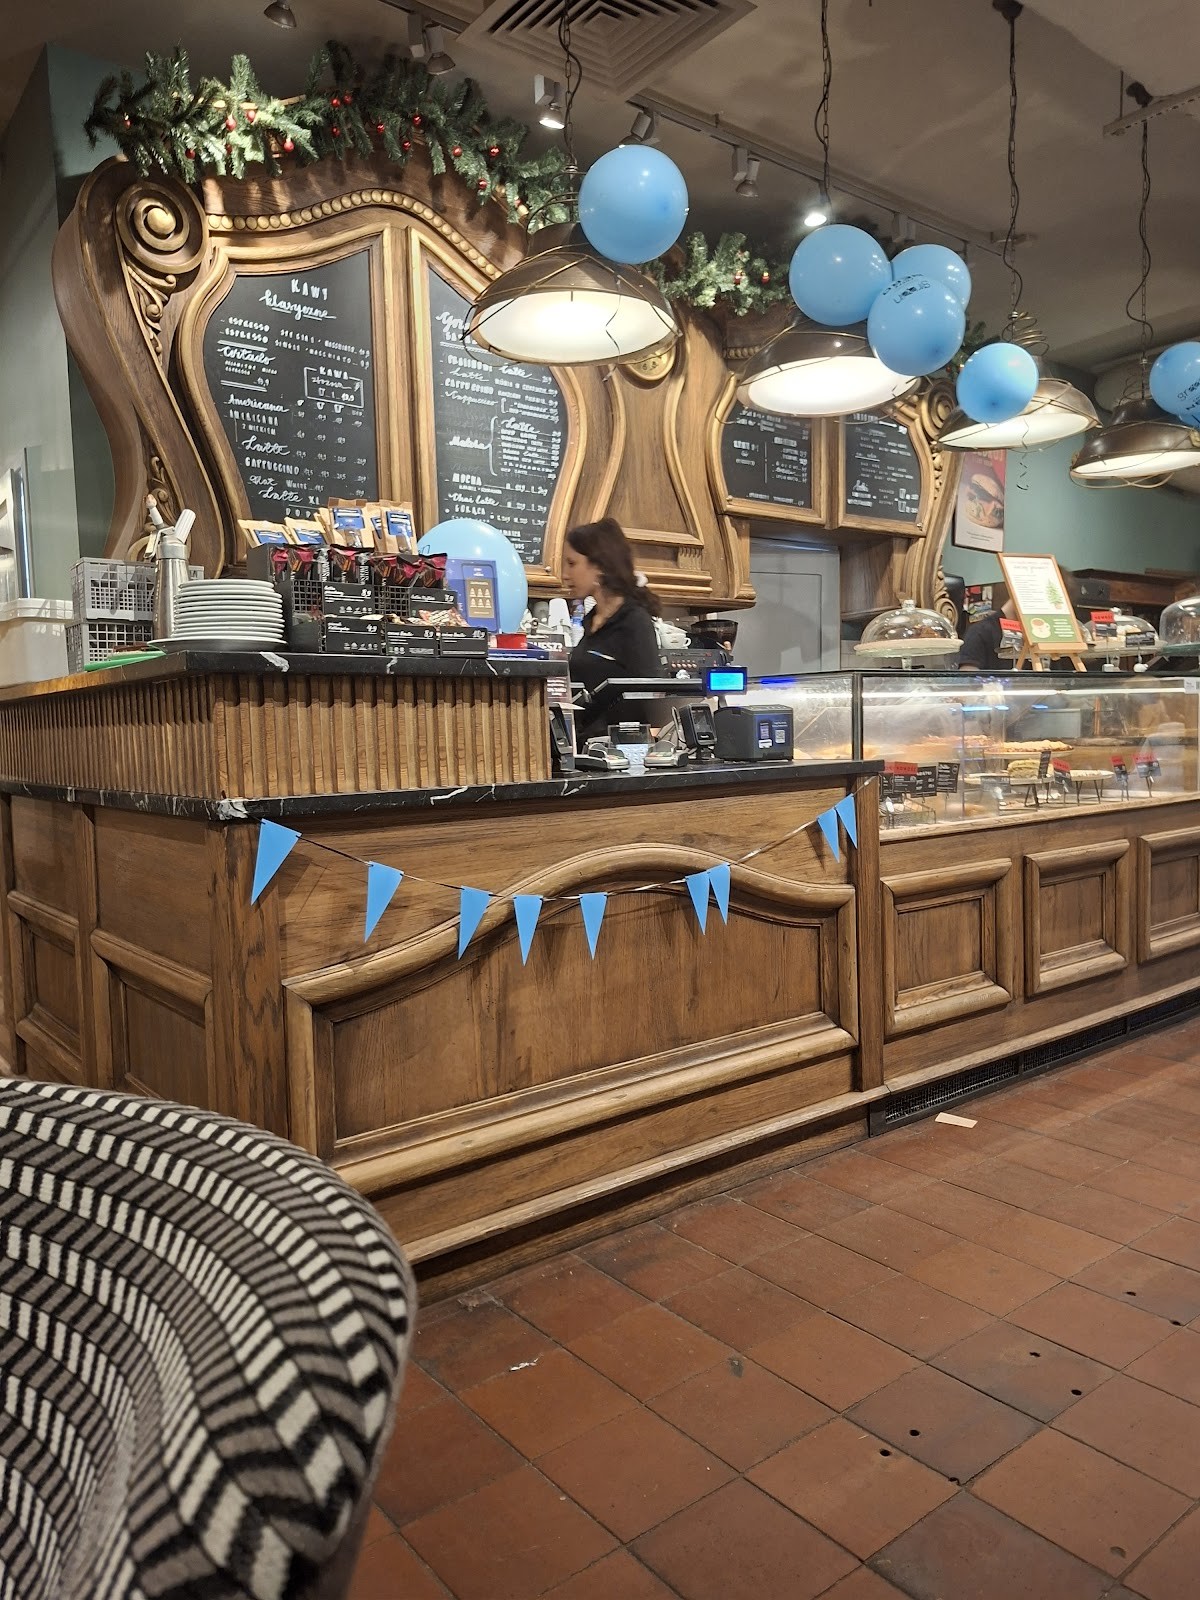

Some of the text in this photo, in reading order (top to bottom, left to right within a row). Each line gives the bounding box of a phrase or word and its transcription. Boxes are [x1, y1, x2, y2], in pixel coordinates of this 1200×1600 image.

[291, 279, 328, 301] KAWY
[228, 316, 270, 332] ESPRESSO
[224, 327, 269, 343] ESPRESSO
[216, 345, 276, 365] Cortado
[319, 366, 349, 380] KAWA
[241, 435, 291, 456] Latte
[244, 456, 300, 475] CAPPUCCINO
[452, 472, 482, 487] MOCHA
[258, 486, 304, 503] Latte
